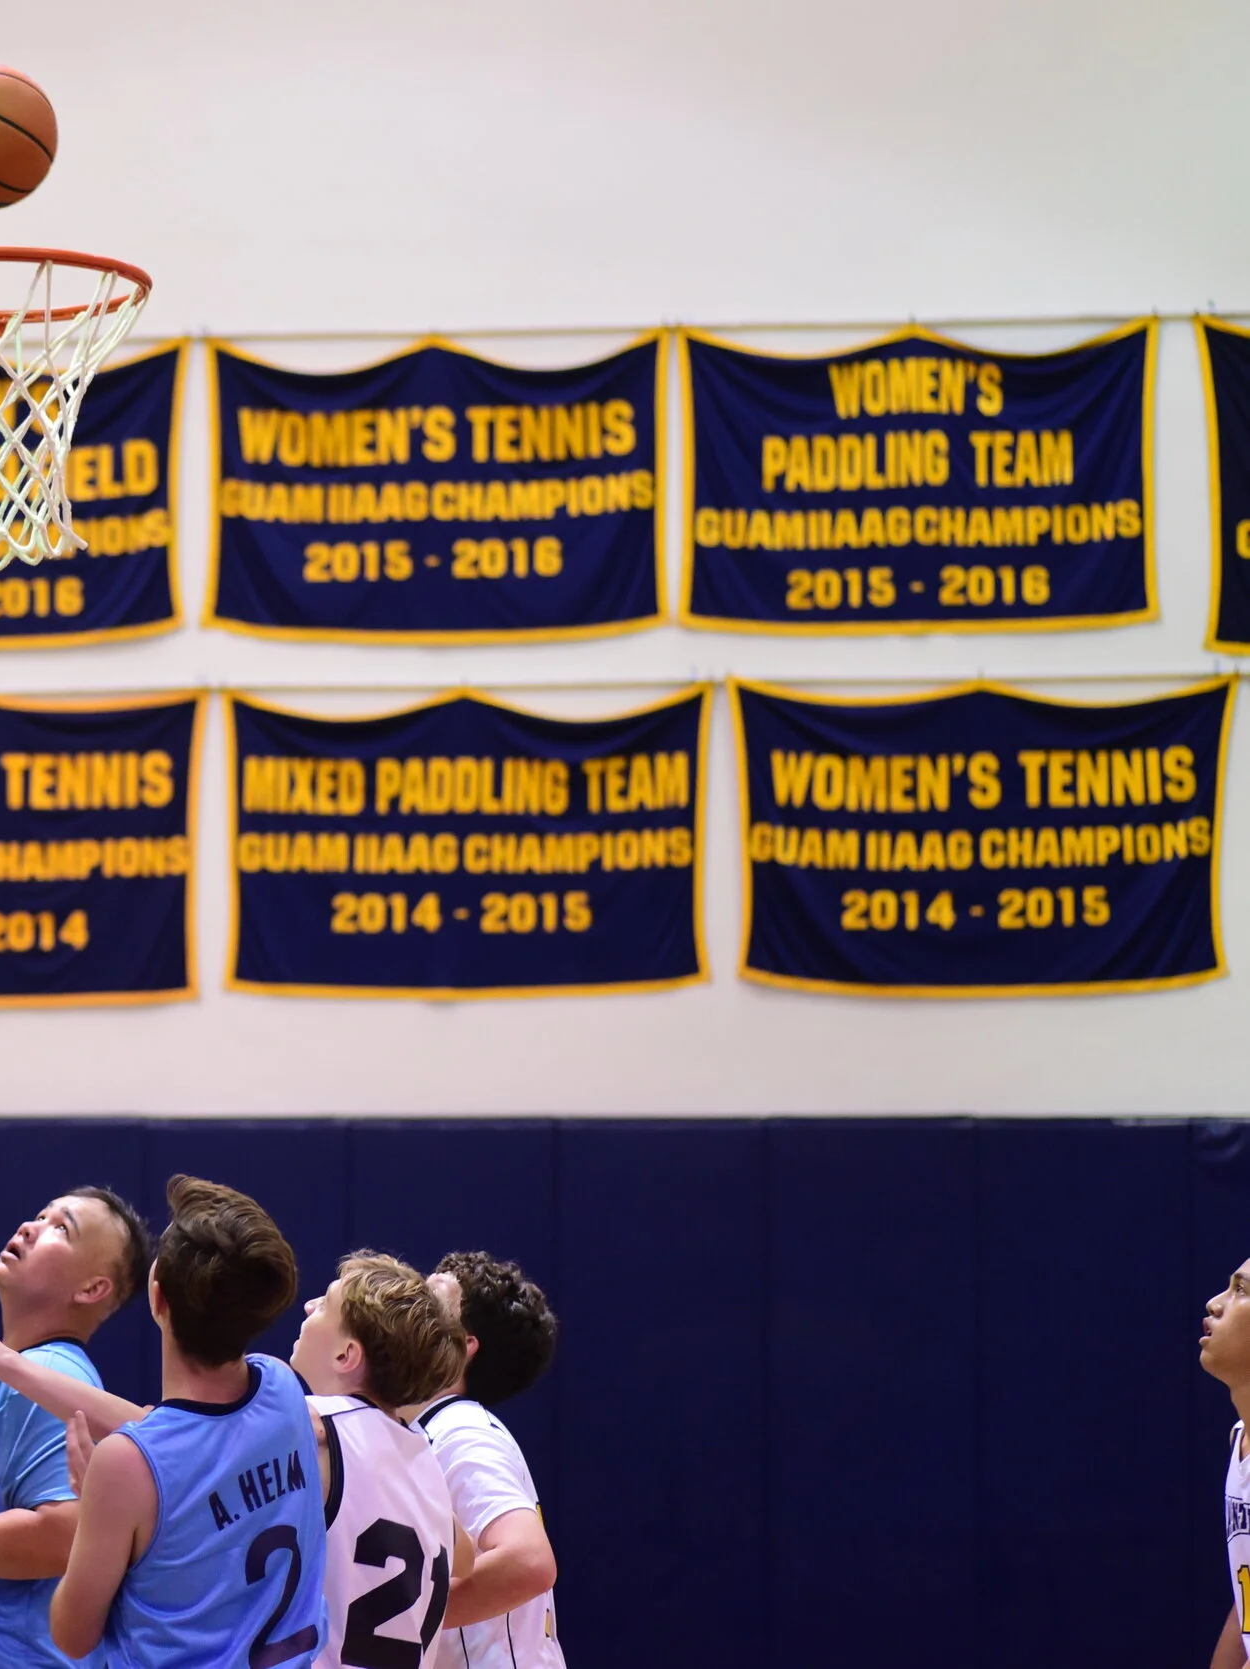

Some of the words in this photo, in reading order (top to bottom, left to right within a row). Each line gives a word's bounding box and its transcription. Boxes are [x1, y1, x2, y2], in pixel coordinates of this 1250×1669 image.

[828, 356, 1005, 419] WOMEN'S
[238, 406, 456, 467] WOMEN'S
[466, 400, 636, 463] TENNIS
[762, 430, 949, 492] PADDLING
[969, 431, 1074, 487] TEAM
[221, 478, 326, 523] GUAM
[430, 470, 654, 521] CHAMPIONS
[693, 508, 808, 550] GUAM
[913, 499, 1142, 546] CHAMPIONS
[304, 540, 413, 582] 2015
[452, 537, 563, 579] 2016
[786, 567, 896, 609] 2015
[939, 565, 1050, 606] 2016
[1, 750, 174, 810] TENNIS
[242, 756, 365, 816] MIXED
[375, 756, 569, 815] PADDLING
[583, 751, 689, 813] TEAM
[771, 750, 1001, 812] WOMEN'S
[1018, 746, 1196, 808] TENNIS
[237, 832, 350, 872] GUAM
[463, 827, 695, 874] CHAMPIONS
[751, 823, 860, 869] GUAM
[980, 817, 1213, 869] CHAMPIONS
[331, 893, 442, 933] 2014
[481, 891, 592, 933] 2015
[841, 890, 956, 930] 2014
[998, 887, 1110, 929] 2015
[208, 1491, 240, 1531] A.
[238, 1449, 306, 1513] HELM
[245, 1525, 318, 1669] 2
